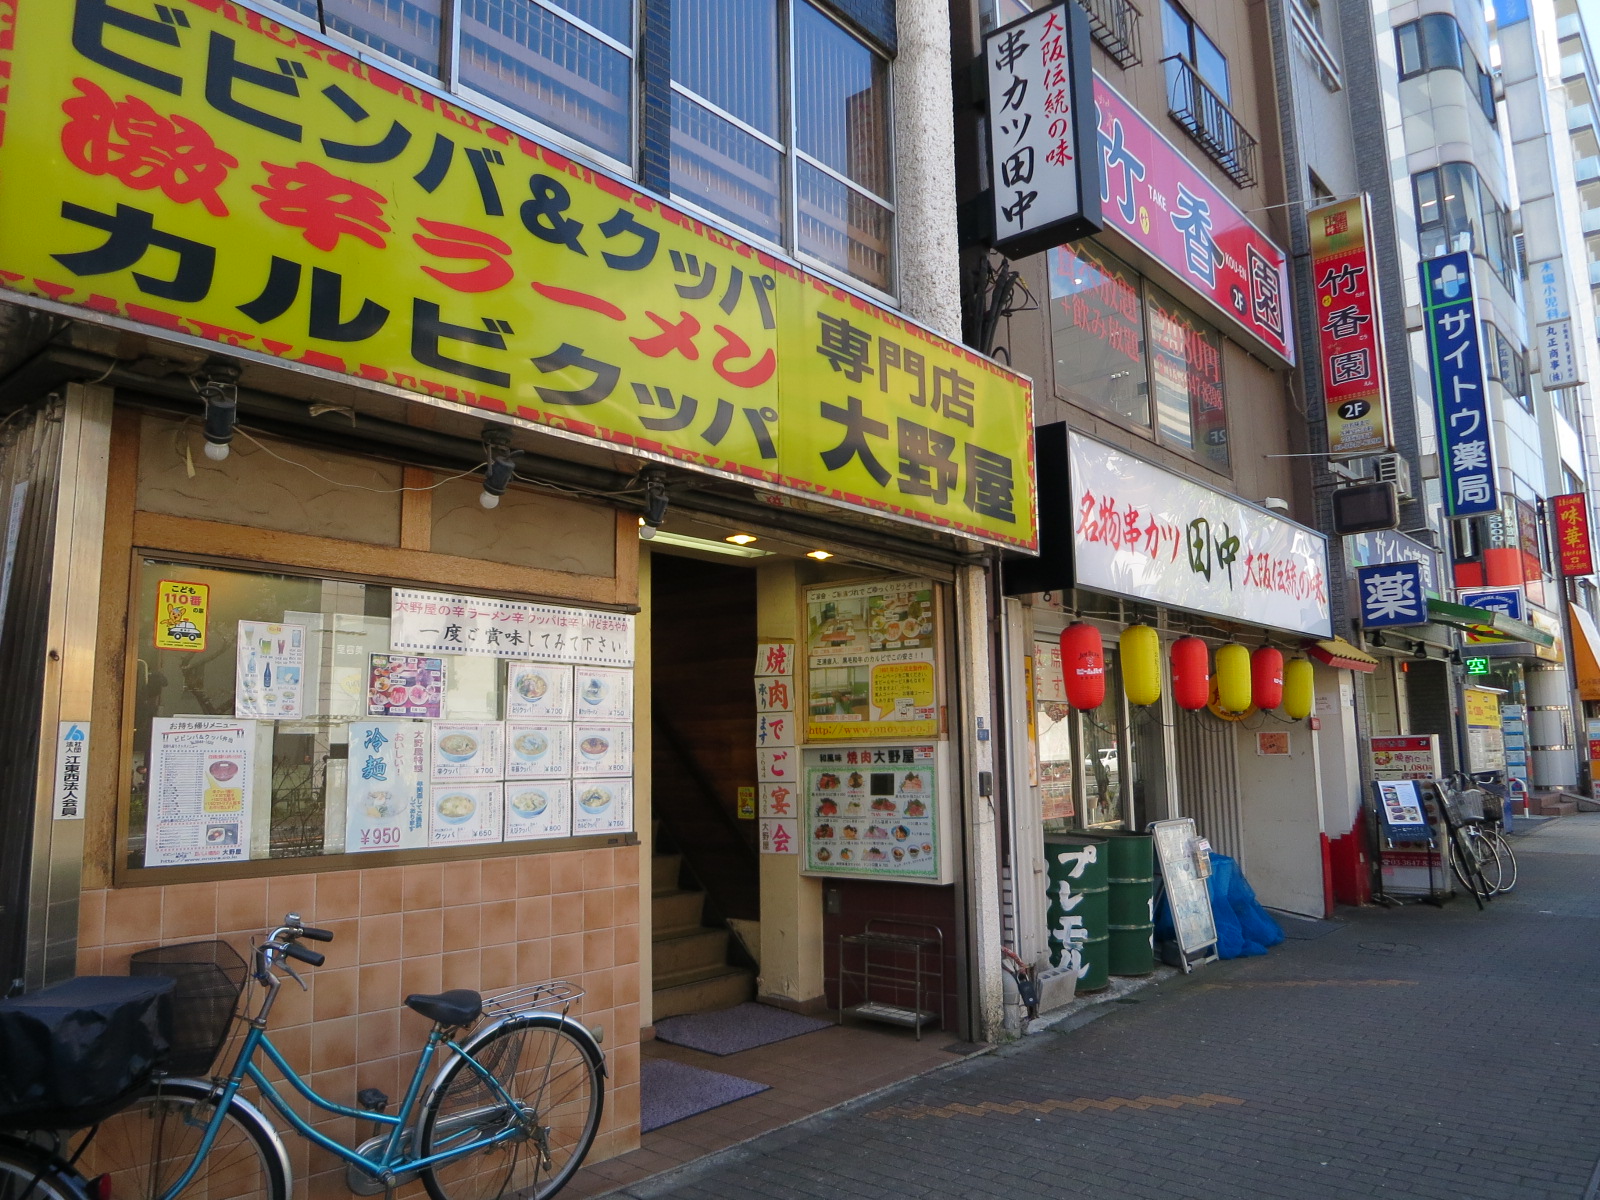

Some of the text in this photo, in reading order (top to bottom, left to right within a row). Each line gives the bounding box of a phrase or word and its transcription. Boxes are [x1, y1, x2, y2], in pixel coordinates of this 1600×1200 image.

[1040, 12, 1073, 167] 大阪伝統の味
[995, 29, 1037, 230] 串カツ田中
[61, 77, 777, 388] 激辛ラーメン
[1147, 185, 1167, 213] TAKE
[1224, 252, 1248, 282] KOU-EN
[1233, 288, 1245, 311] 2F
[1318, 263, 1370, 386] 竹香園
[50, 201, 778, 460] カルビクッパ
[817, 310, 976, 428] 専門店
[1344, 402, 1363, 419] 2F
[1438, 309, 1490, 506] サイトウ薬局
[819, 396, 1018, 525] 大野屋
[1076, 488, 1326, 605] 名物串カツ 田中 大阪伝統の味
[164, 593, 202, 606] 110番
[171, 585, 197, 595] こども
[1364, 571, 1418, 620] 薬
[1466, 657, 1488, 674] 空
[170, 722, 238, 730] お持ち帰りメニュー
[361, 727, 389, 782] 冷麺
[847, 749, 914, 764] 焼肉大野屋
[61, 755, 82, 817] 江東西法人会員
[360, 827, 401, 845] ¥950
[472, 829, 492, 837] ¥650
[1390, 859, 1442, 867] 03-3647-898
[1053, 845, 1097, 979] プレモル
